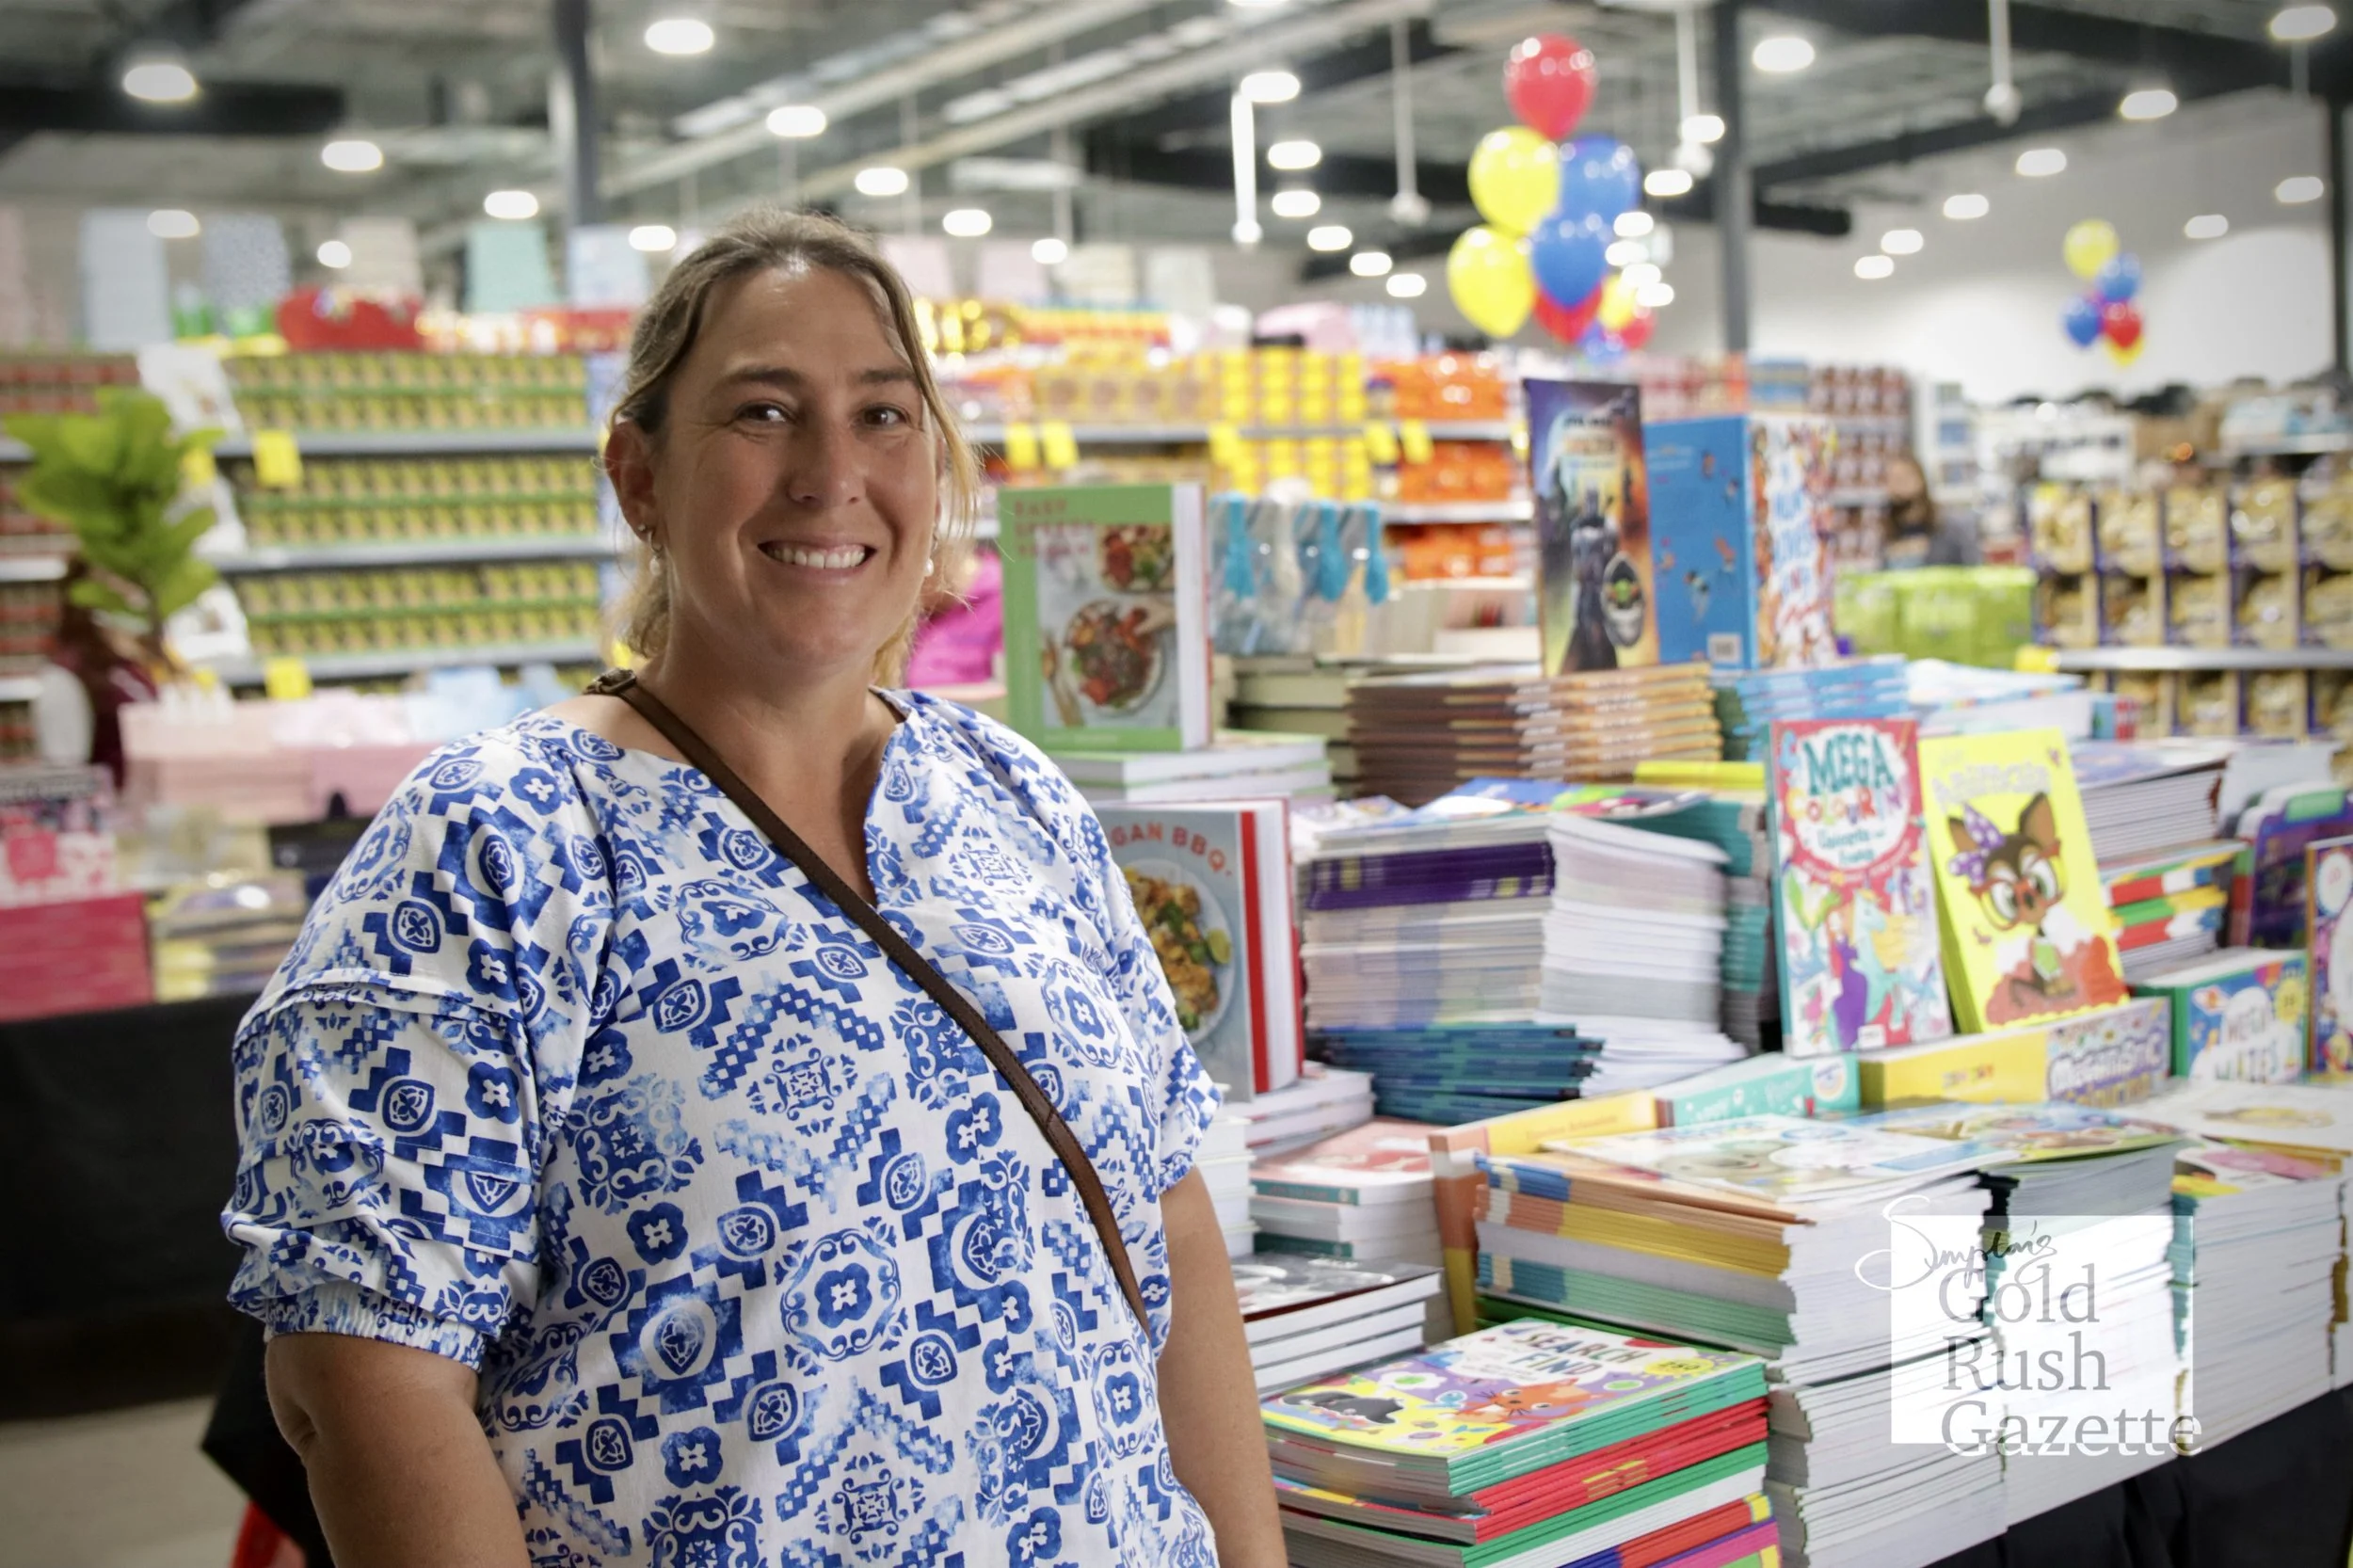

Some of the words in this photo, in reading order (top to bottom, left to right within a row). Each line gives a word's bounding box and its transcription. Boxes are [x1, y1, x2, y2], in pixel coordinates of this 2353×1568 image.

[1803, 733, 1895, 795] MEGA
[1108, 822, 1163, 847] GAN
[1513, 1332, 1652, 1364] SEARCH
[1508, 1352, 1603, 1376] FIND
